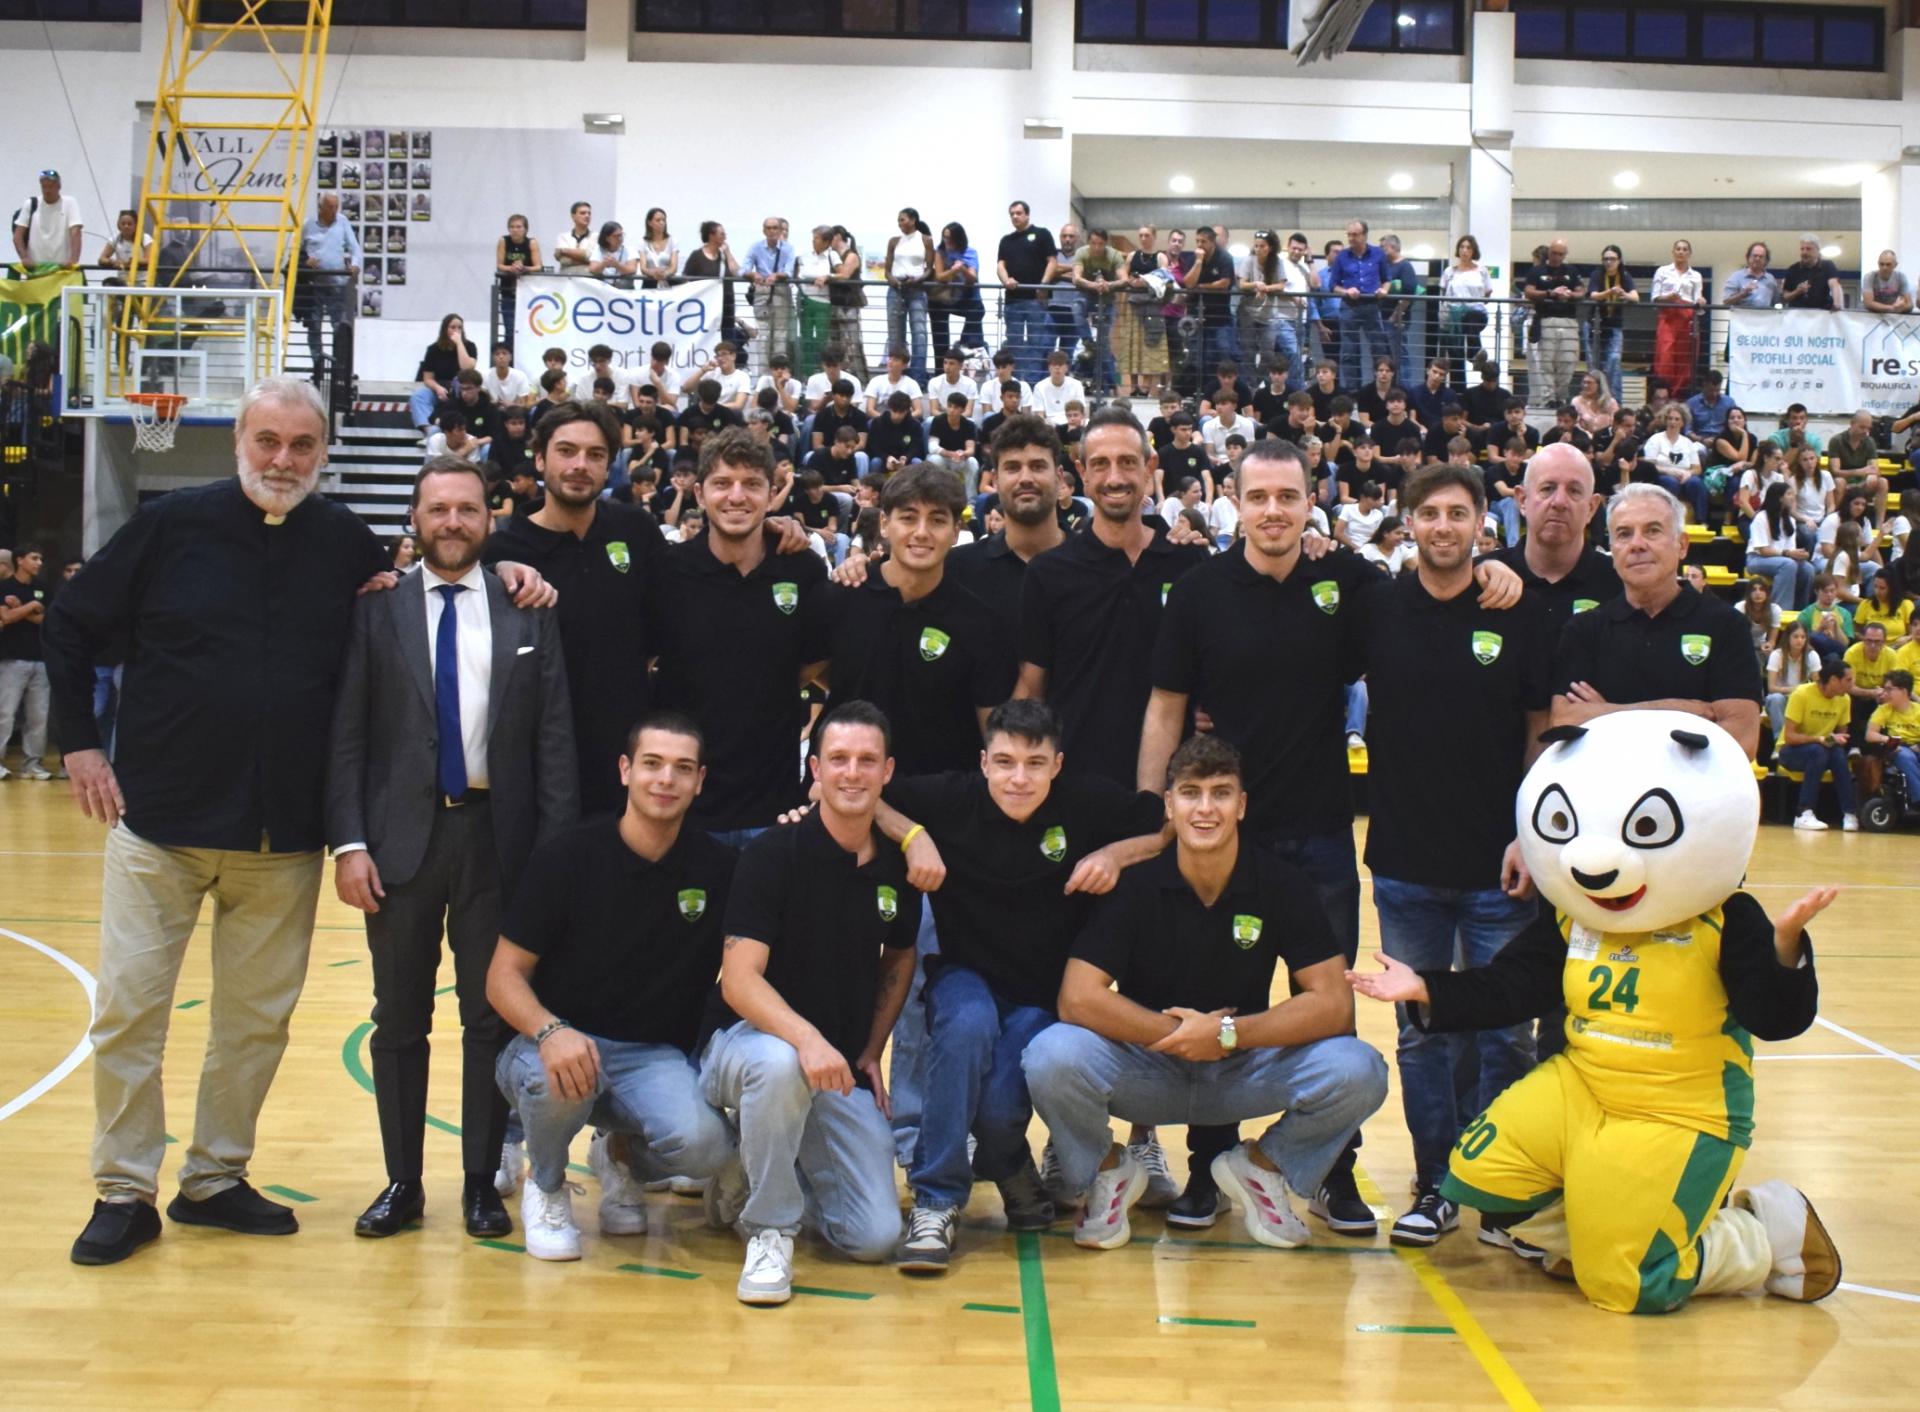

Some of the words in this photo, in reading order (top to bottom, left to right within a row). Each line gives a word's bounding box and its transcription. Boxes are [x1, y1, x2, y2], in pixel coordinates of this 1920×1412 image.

[572, 296, 708, 335] estra
[1736, 334, 1780, 347] SEGUICI
[1784, 335, 1804, 348] SUI
[1808, 336, 1846, 349] NOSTRI
[1751, 352, 1793, 365] PROFILI
[1797, 353, 1836, 366] SOCIAL
[1860, 380, 1912, 391] RIQUALIFICA
[1587, 965, 1641, 1014] 24
[1455, 1113, 1498, 1161] 20
